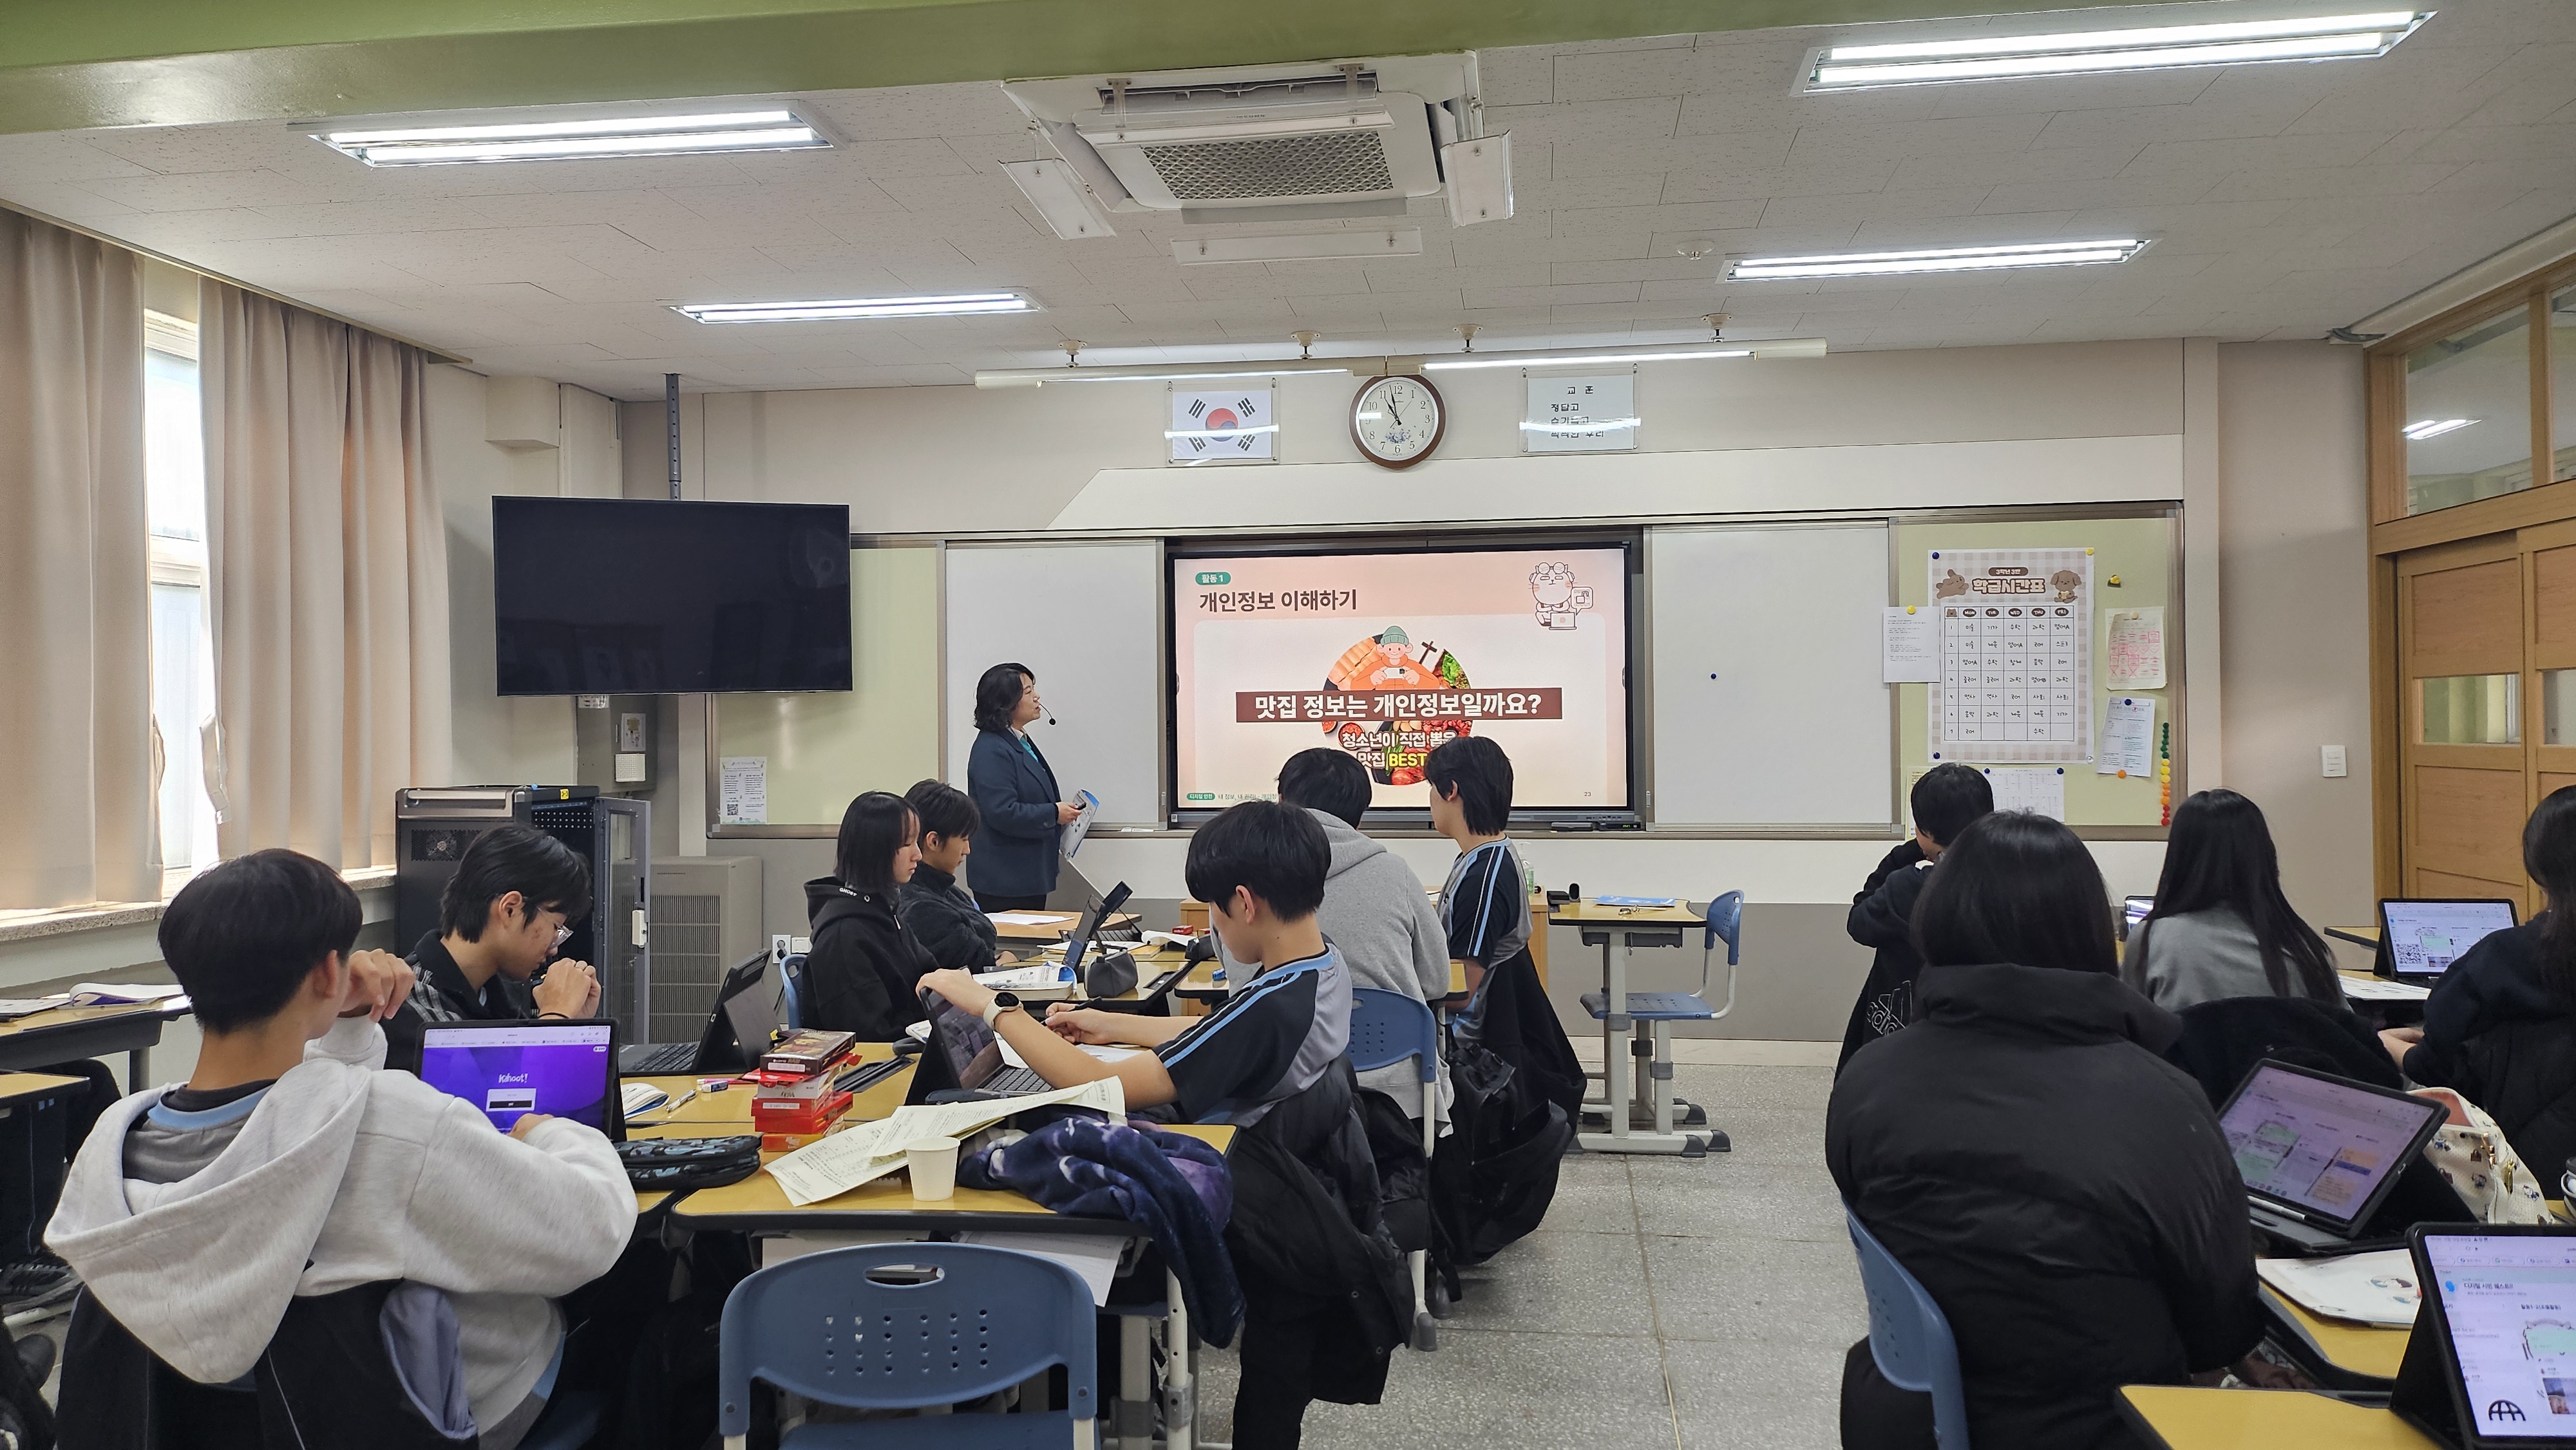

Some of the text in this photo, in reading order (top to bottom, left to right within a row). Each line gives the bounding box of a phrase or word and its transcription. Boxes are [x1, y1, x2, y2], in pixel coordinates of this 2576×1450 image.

[1394, 386, 1403, 394] 12
[1368, 402, 1378, 410] 10
[1420, 400, 1426, 409] 2
[1551, 403, 1579, 412] 정답고
[1425, 415, 1430, 423] 3
[1379, 442, 1385, 450] 7
[1394, 445, 1401, 453] 6
[1409, 441, 1415, 449] 5
[1202, 574, 1217, 583] 활동
[1973, 578, 2045, 594] 학급시간표
[1200, 589, 1356, 612] 개인정보 이해하기
[1965, 623, 1974, 632] 미술
[1965, 641, 1974, 649] 미술
[1255, 693, 1542, 719] 맛집 정보는 개인정보일까요?
[1341, 732, 1396, 748] 청소년이
[1399, 732, 1426, 748] 직접
[1357, 752, 1427, 767] 맛집 BEST
[498, 1073, 528, 1083] Kahoot!
